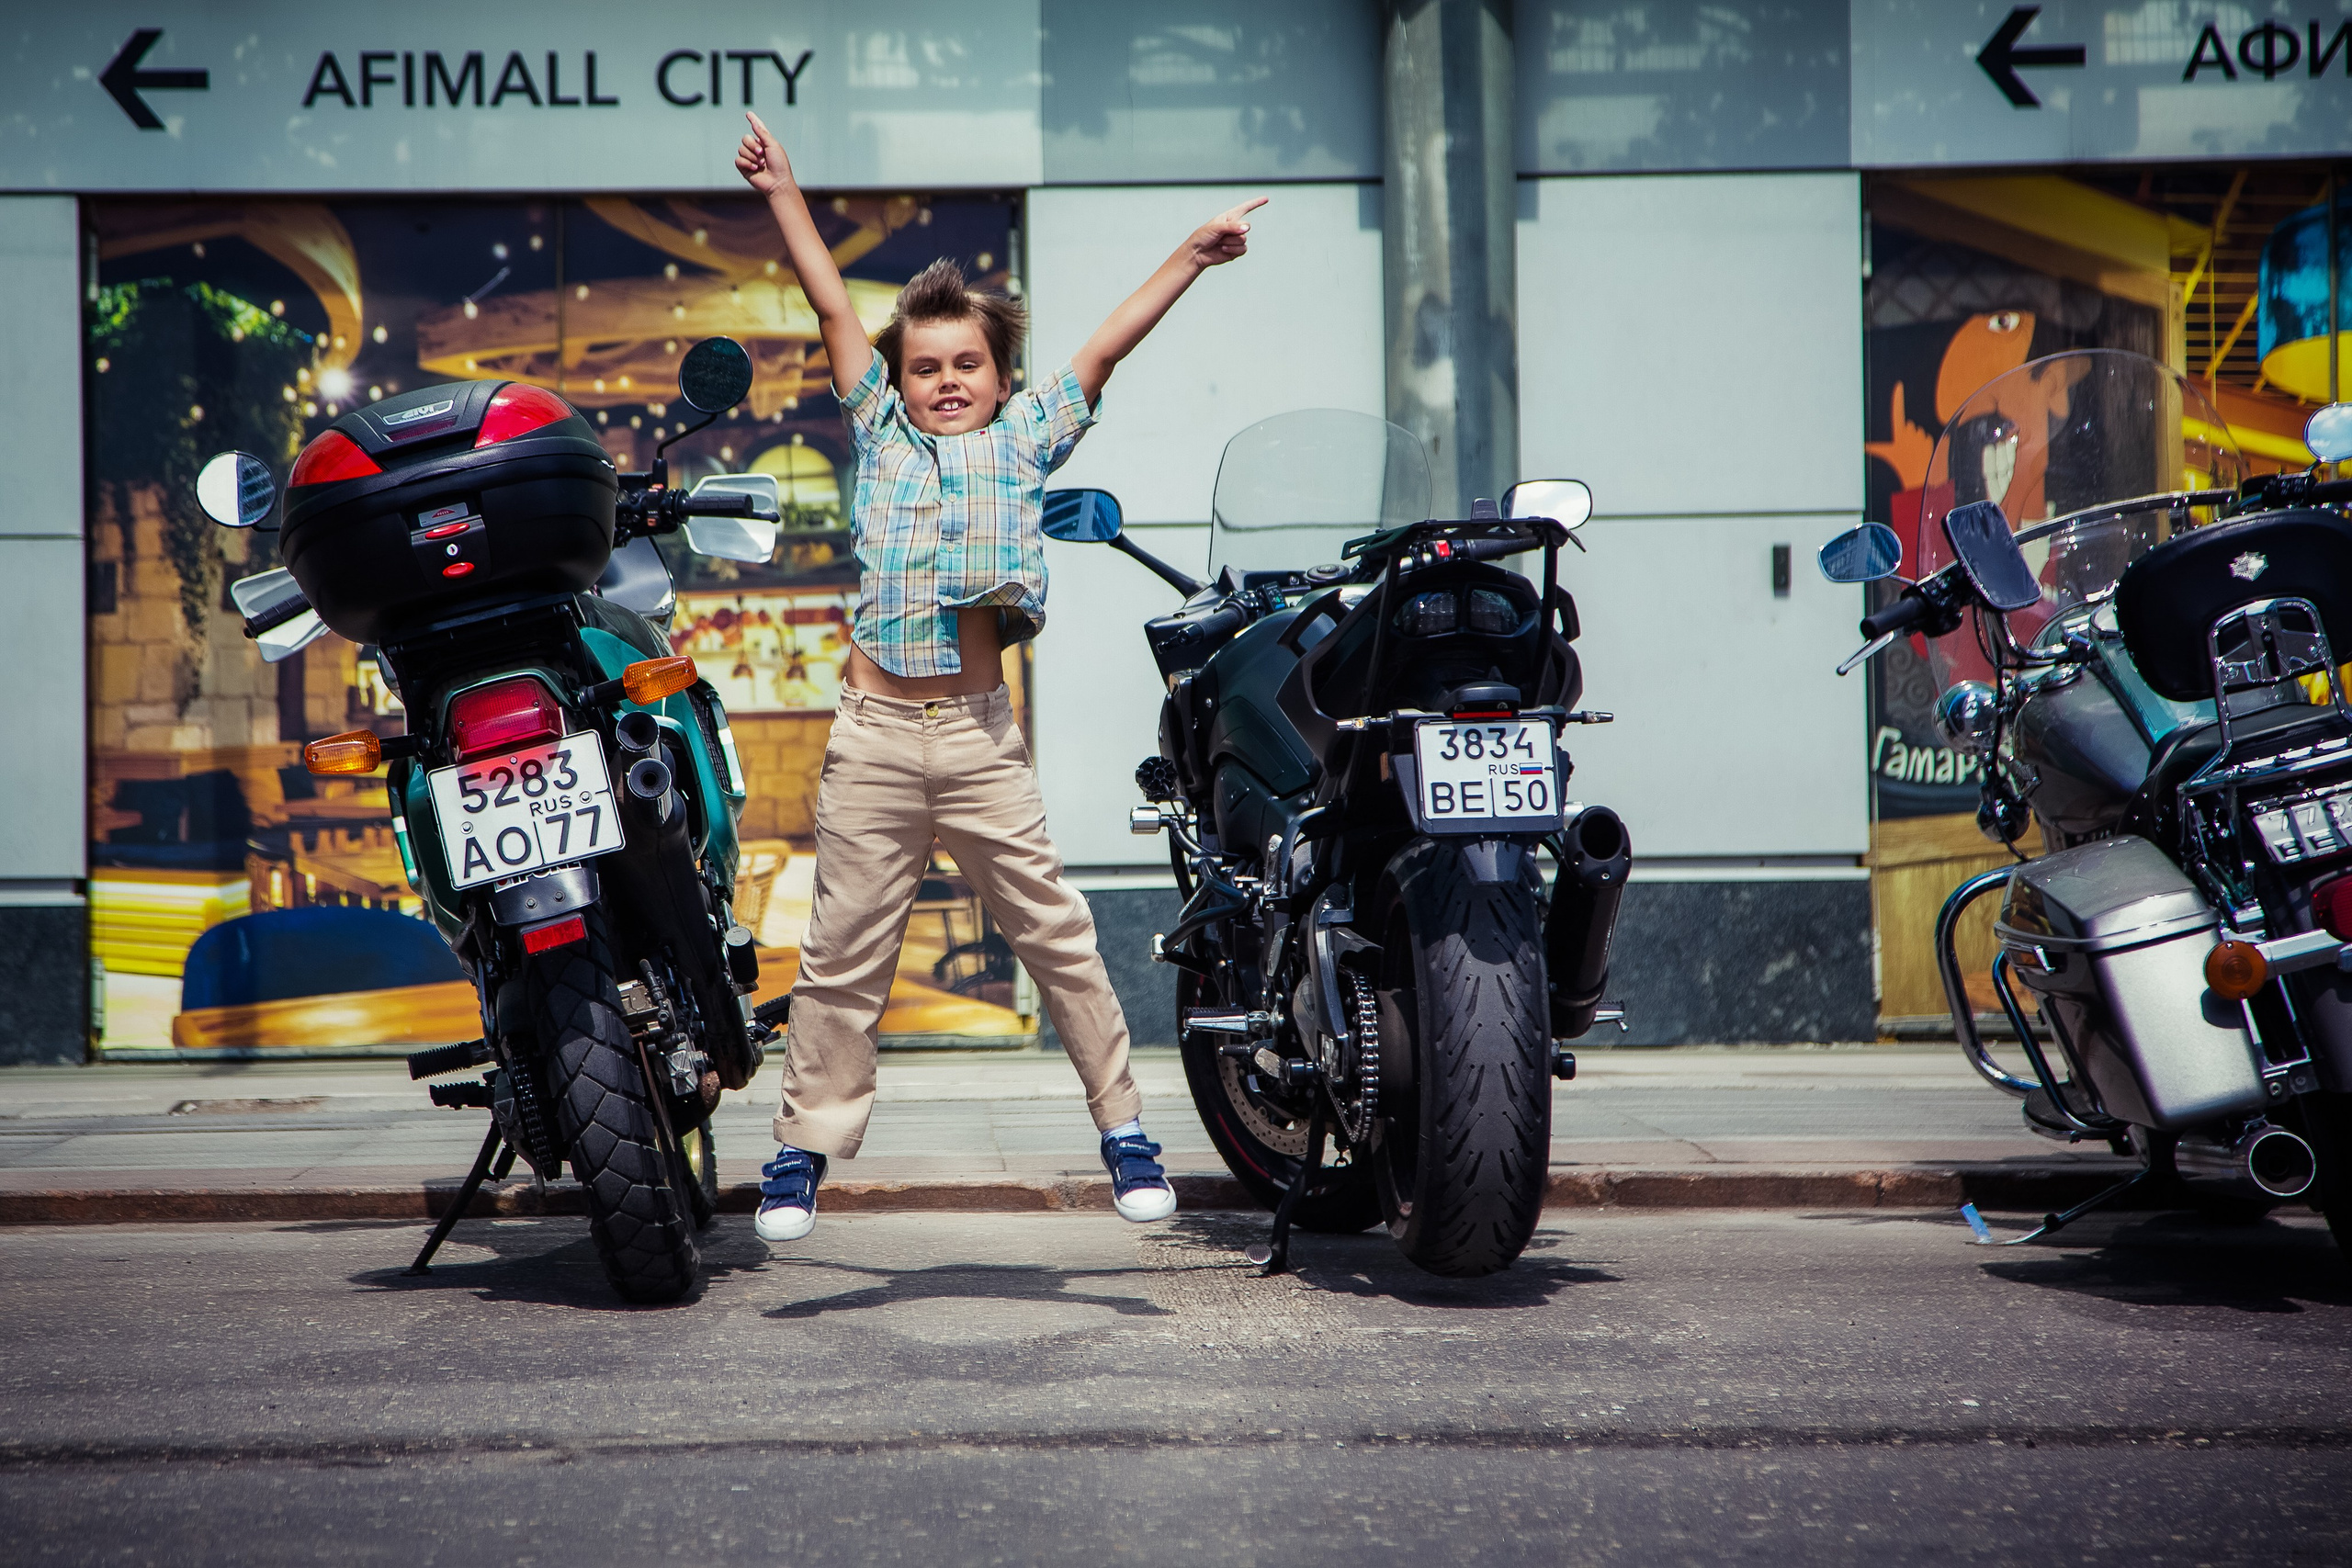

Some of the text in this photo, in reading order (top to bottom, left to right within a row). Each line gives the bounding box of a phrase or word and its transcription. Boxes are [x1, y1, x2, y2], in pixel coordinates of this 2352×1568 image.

[2182, 17, 2352, 84] АФИ
[300, 48, 815, 108] AFIMALL CITY
[1438, 727, 1534, 761] 3834
[458, 749, 579, 814] 5283
[1488, 763, 1520, 775] RUS
[529, 794, 573, 818] RUS
[1504, 779, 1549, 812] 50
[545, 804, 602, 855] 77
